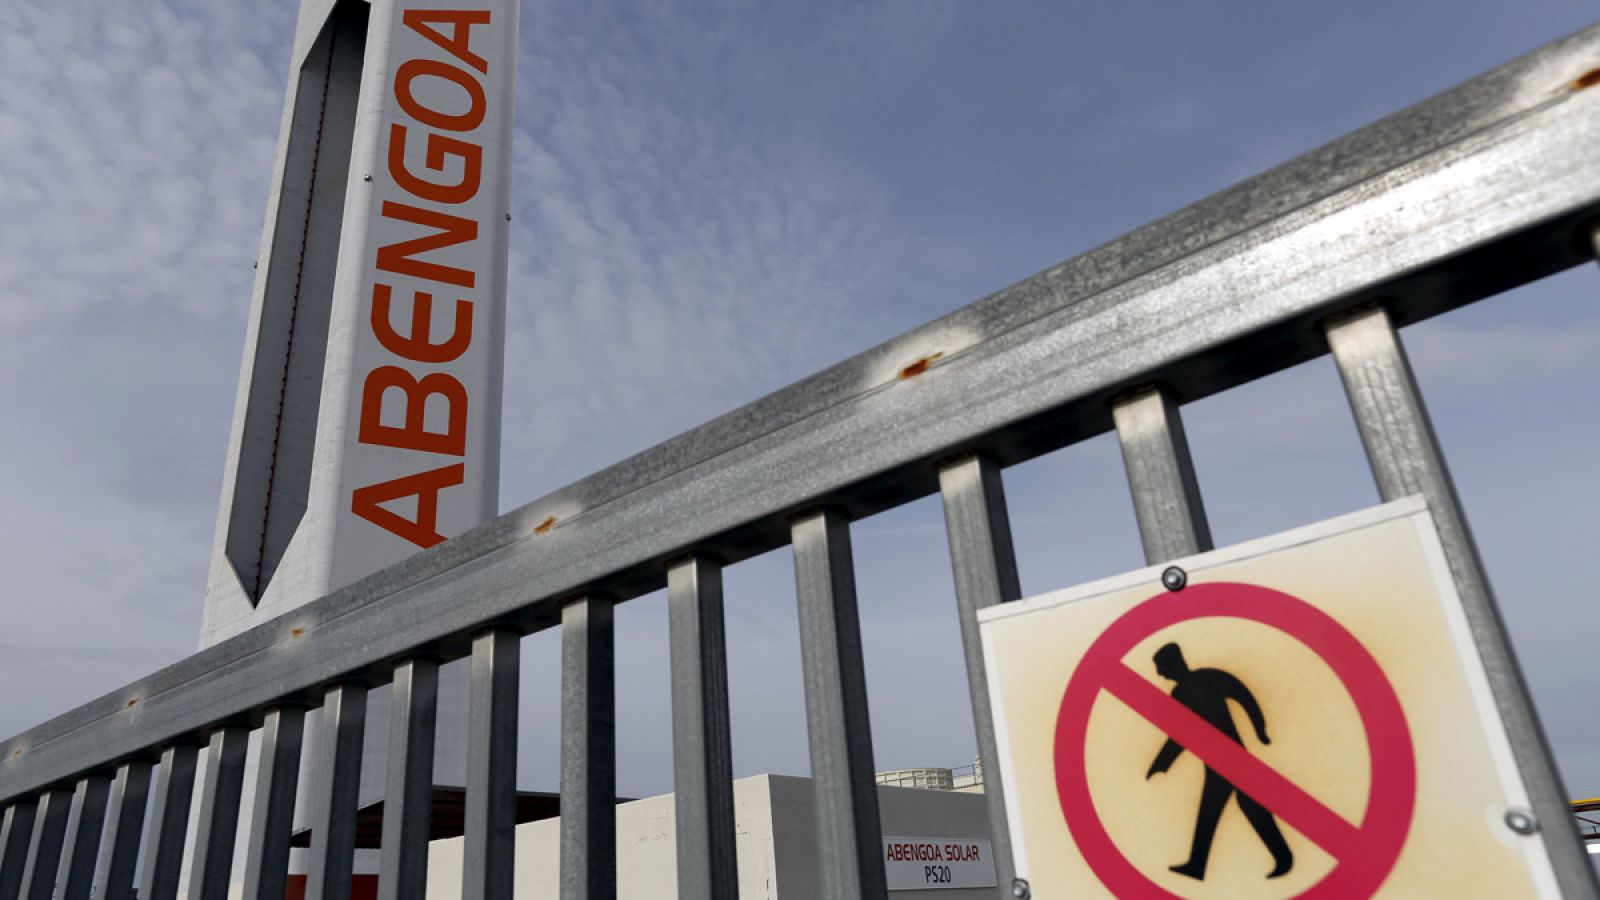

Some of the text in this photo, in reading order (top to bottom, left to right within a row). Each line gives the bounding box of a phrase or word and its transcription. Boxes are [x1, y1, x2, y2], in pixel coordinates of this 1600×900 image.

[351, 9, 491, 549] ABENGOA
[887, 843, 980, 861] ABENGOA SOLAR
[925, 866, 951, 883] PS20
